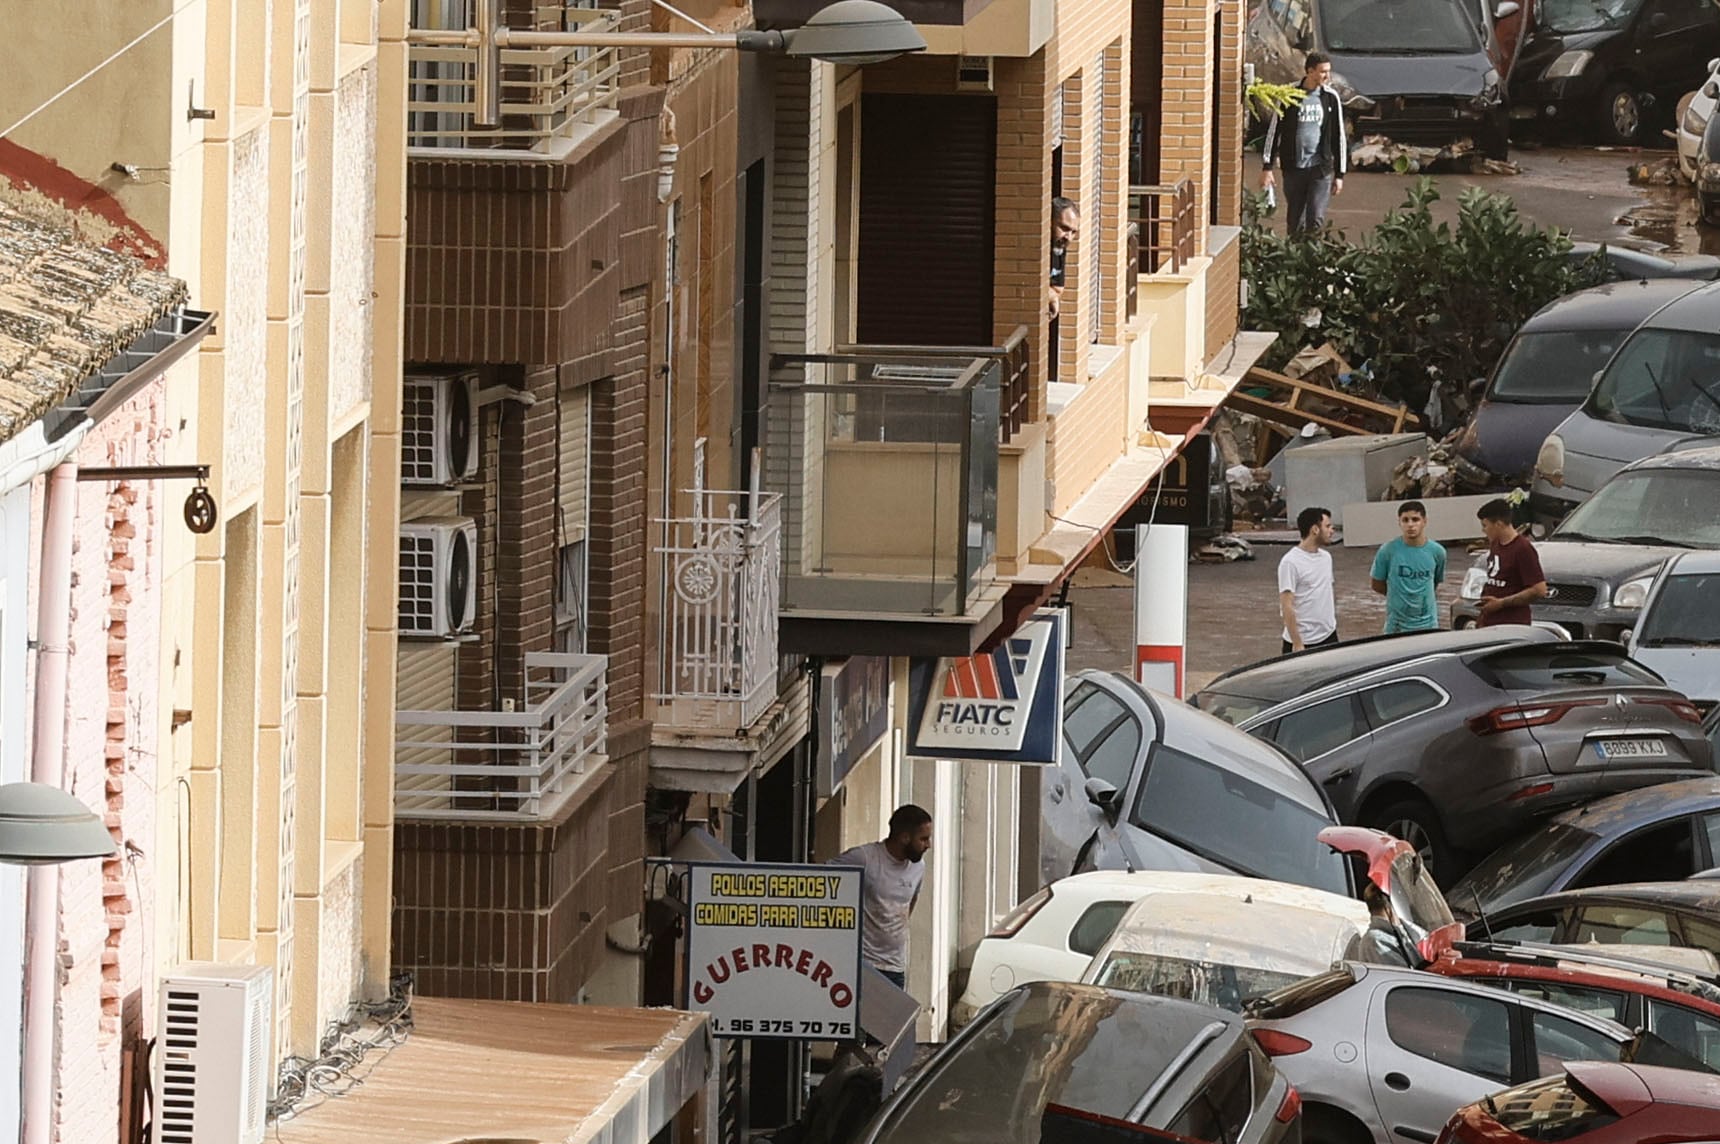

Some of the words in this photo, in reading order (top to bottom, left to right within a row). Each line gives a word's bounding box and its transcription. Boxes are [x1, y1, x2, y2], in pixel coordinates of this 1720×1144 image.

[937, 703, 1016, 726] FIATC
[933, 724, 1011, 736] SEGUROS
[711, 873, 766, 897] POLLOS
[768, 875, 826, 898] ASADOS
[828, 876, 841, 899] Y
[695, 903, 757, 926] COMIDAS
[760, 904, 799, 928] PARA
[801, 905, 856, 929] LLEVAR
[694, 943, 853, 1009] GUERRERO
[731, 1019, 753, 1032] 96
[759, 1020, 793, 1033] 375
[800, 1021, 823, 1034] 70
[829, 1022, 851, 1035] 76
